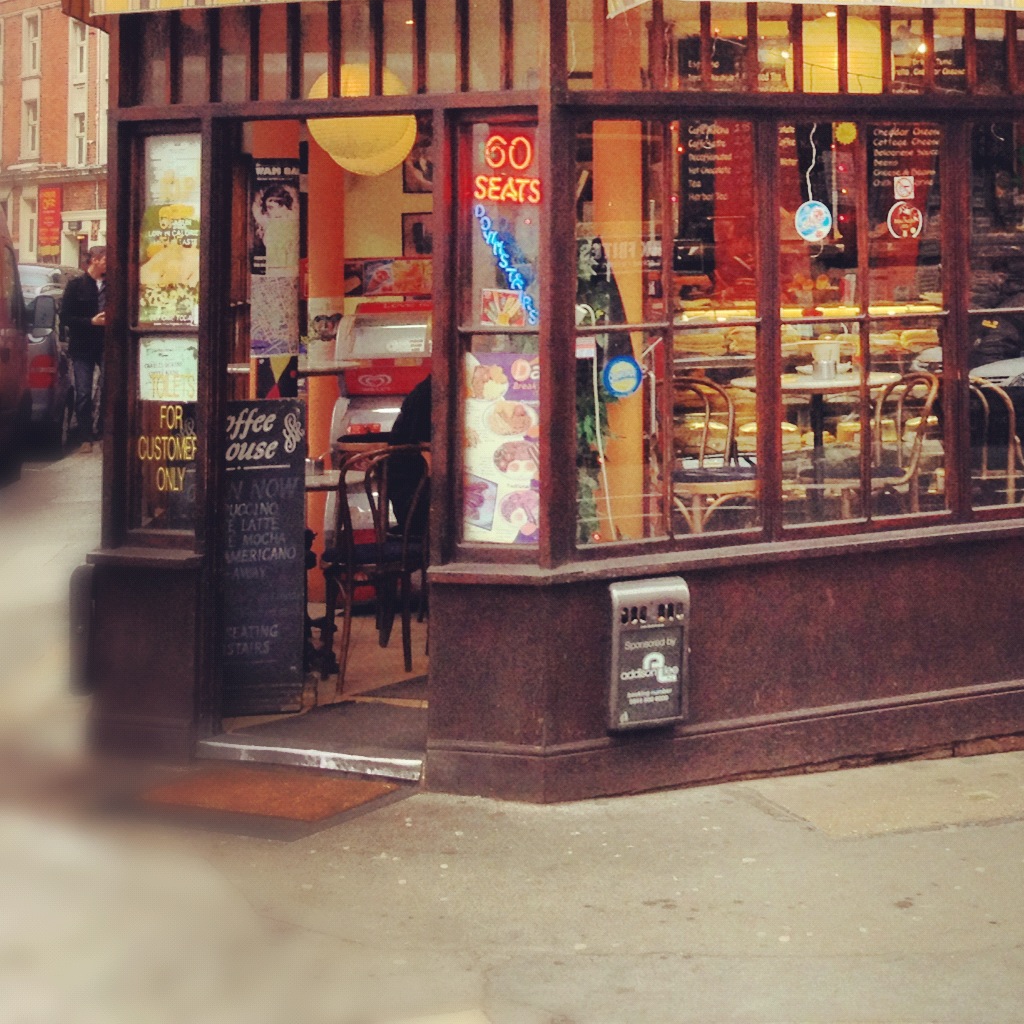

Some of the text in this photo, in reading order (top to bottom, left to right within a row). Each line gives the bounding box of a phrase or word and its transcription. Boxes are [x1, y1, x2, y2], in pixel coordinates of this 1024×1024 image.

[485, 135, 532, 170] 60
[473, 175, 541, 204] SEATS
[160, 405, 183, 429] FOR
[225, 440, 279, 462] ouse
[156, 466, 186, 491] ONLY
[227, 503, 279, 518] UCCINO
[624, 637, 677, 651] Sponsored by
